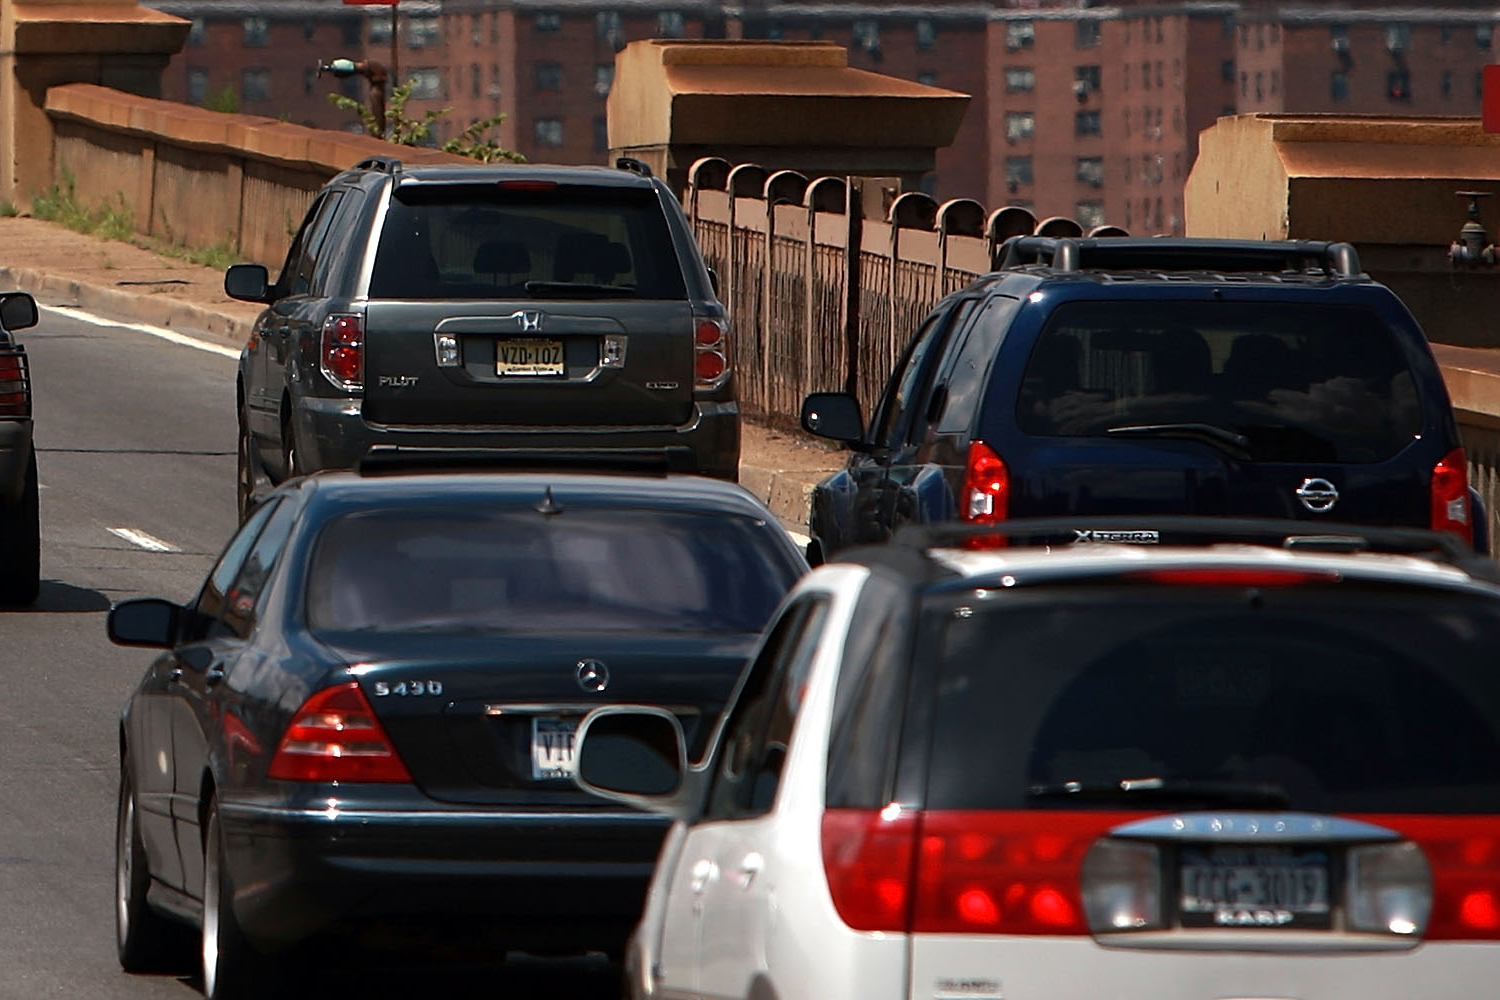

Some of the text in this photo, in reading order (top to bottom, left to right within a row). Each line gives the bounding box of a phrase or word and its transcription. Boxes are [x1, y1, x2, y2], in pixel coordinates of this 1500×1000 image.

[378, 376, 419, 386] PILOT
[1073, 528, 1159, 544] XTERRA
[374, 680, 443, 696] S430
